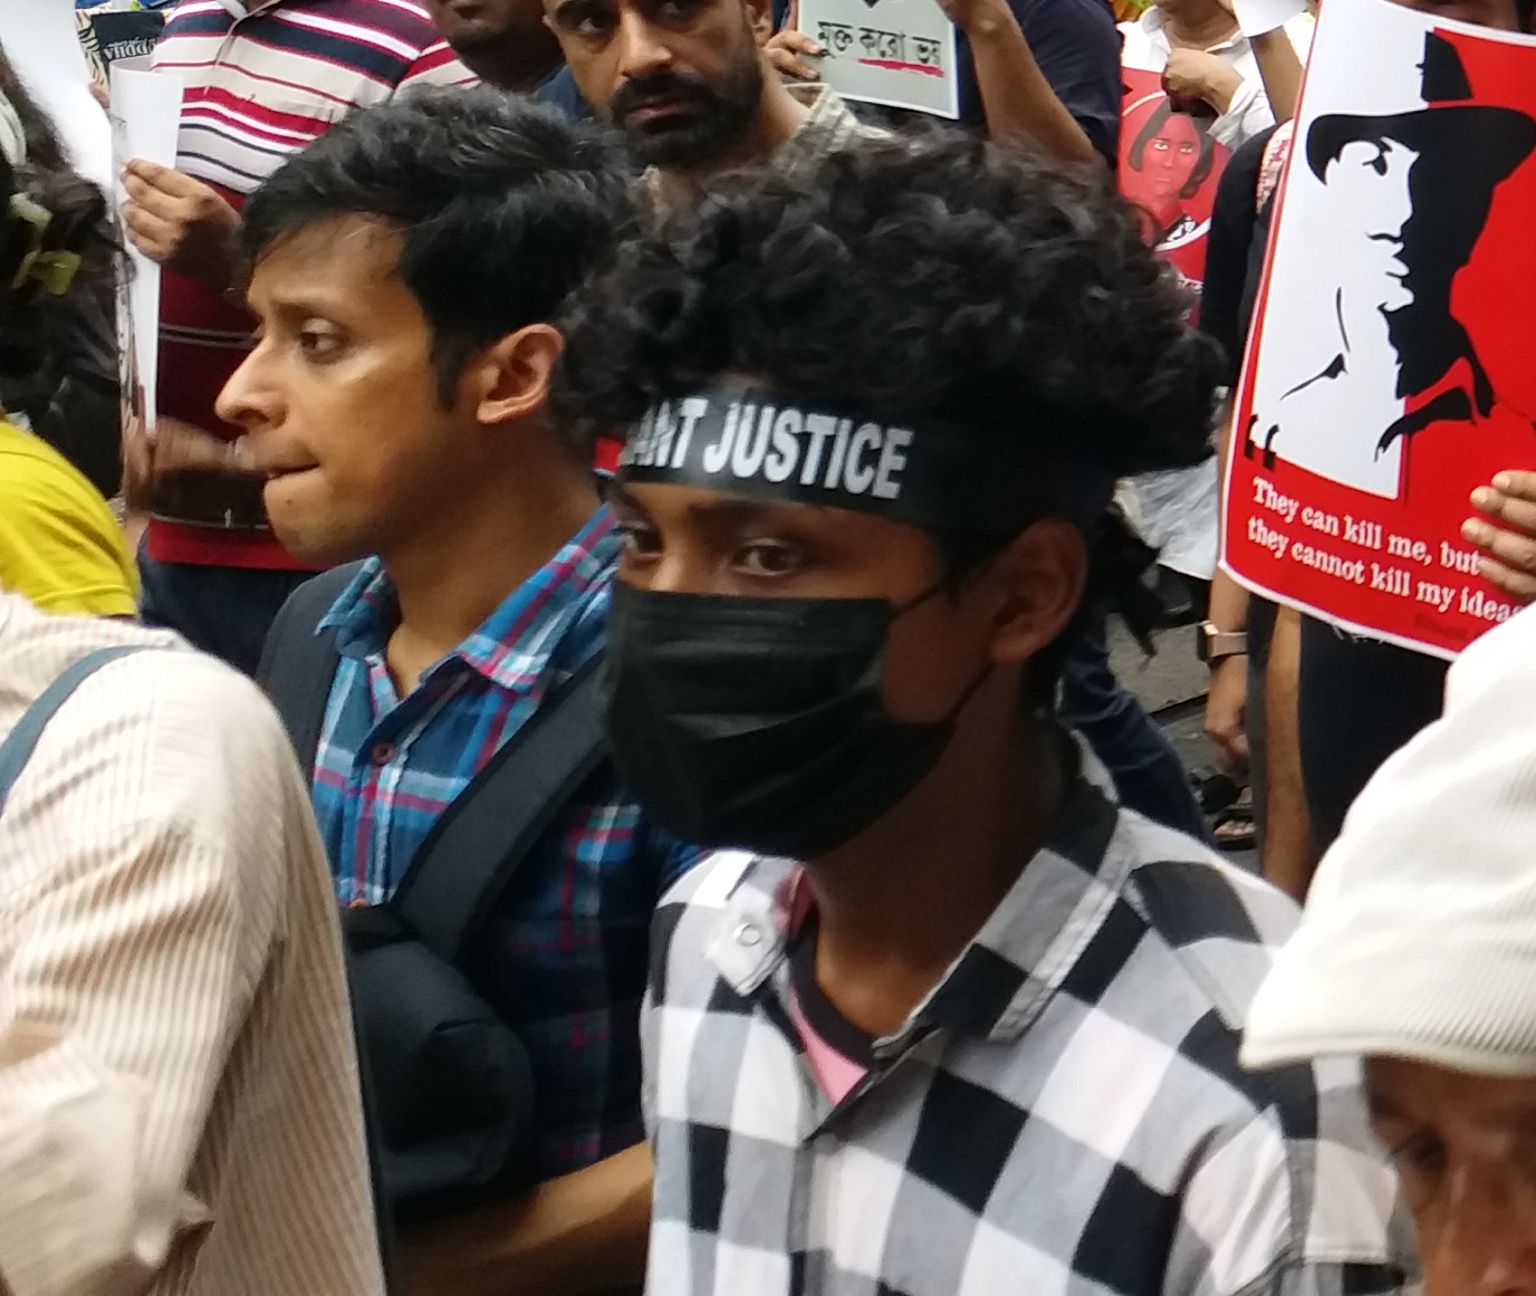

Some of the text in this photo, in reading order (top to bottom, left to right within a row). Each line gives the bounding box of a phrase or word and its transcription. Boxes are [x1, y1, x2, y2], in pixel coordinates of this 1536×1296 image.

[818, 21, 853, 59] মুক্ত
[703, 402, 914, 500] JUSTICE
[1248, 516, 1289, 559] they
[1291, 540, 1366, 584] cannot
[1370, 562, 1411, 597] kill
[1416, 580, 1456, 614] my
[1253, 475, 1480, 576] They can kill me, but
